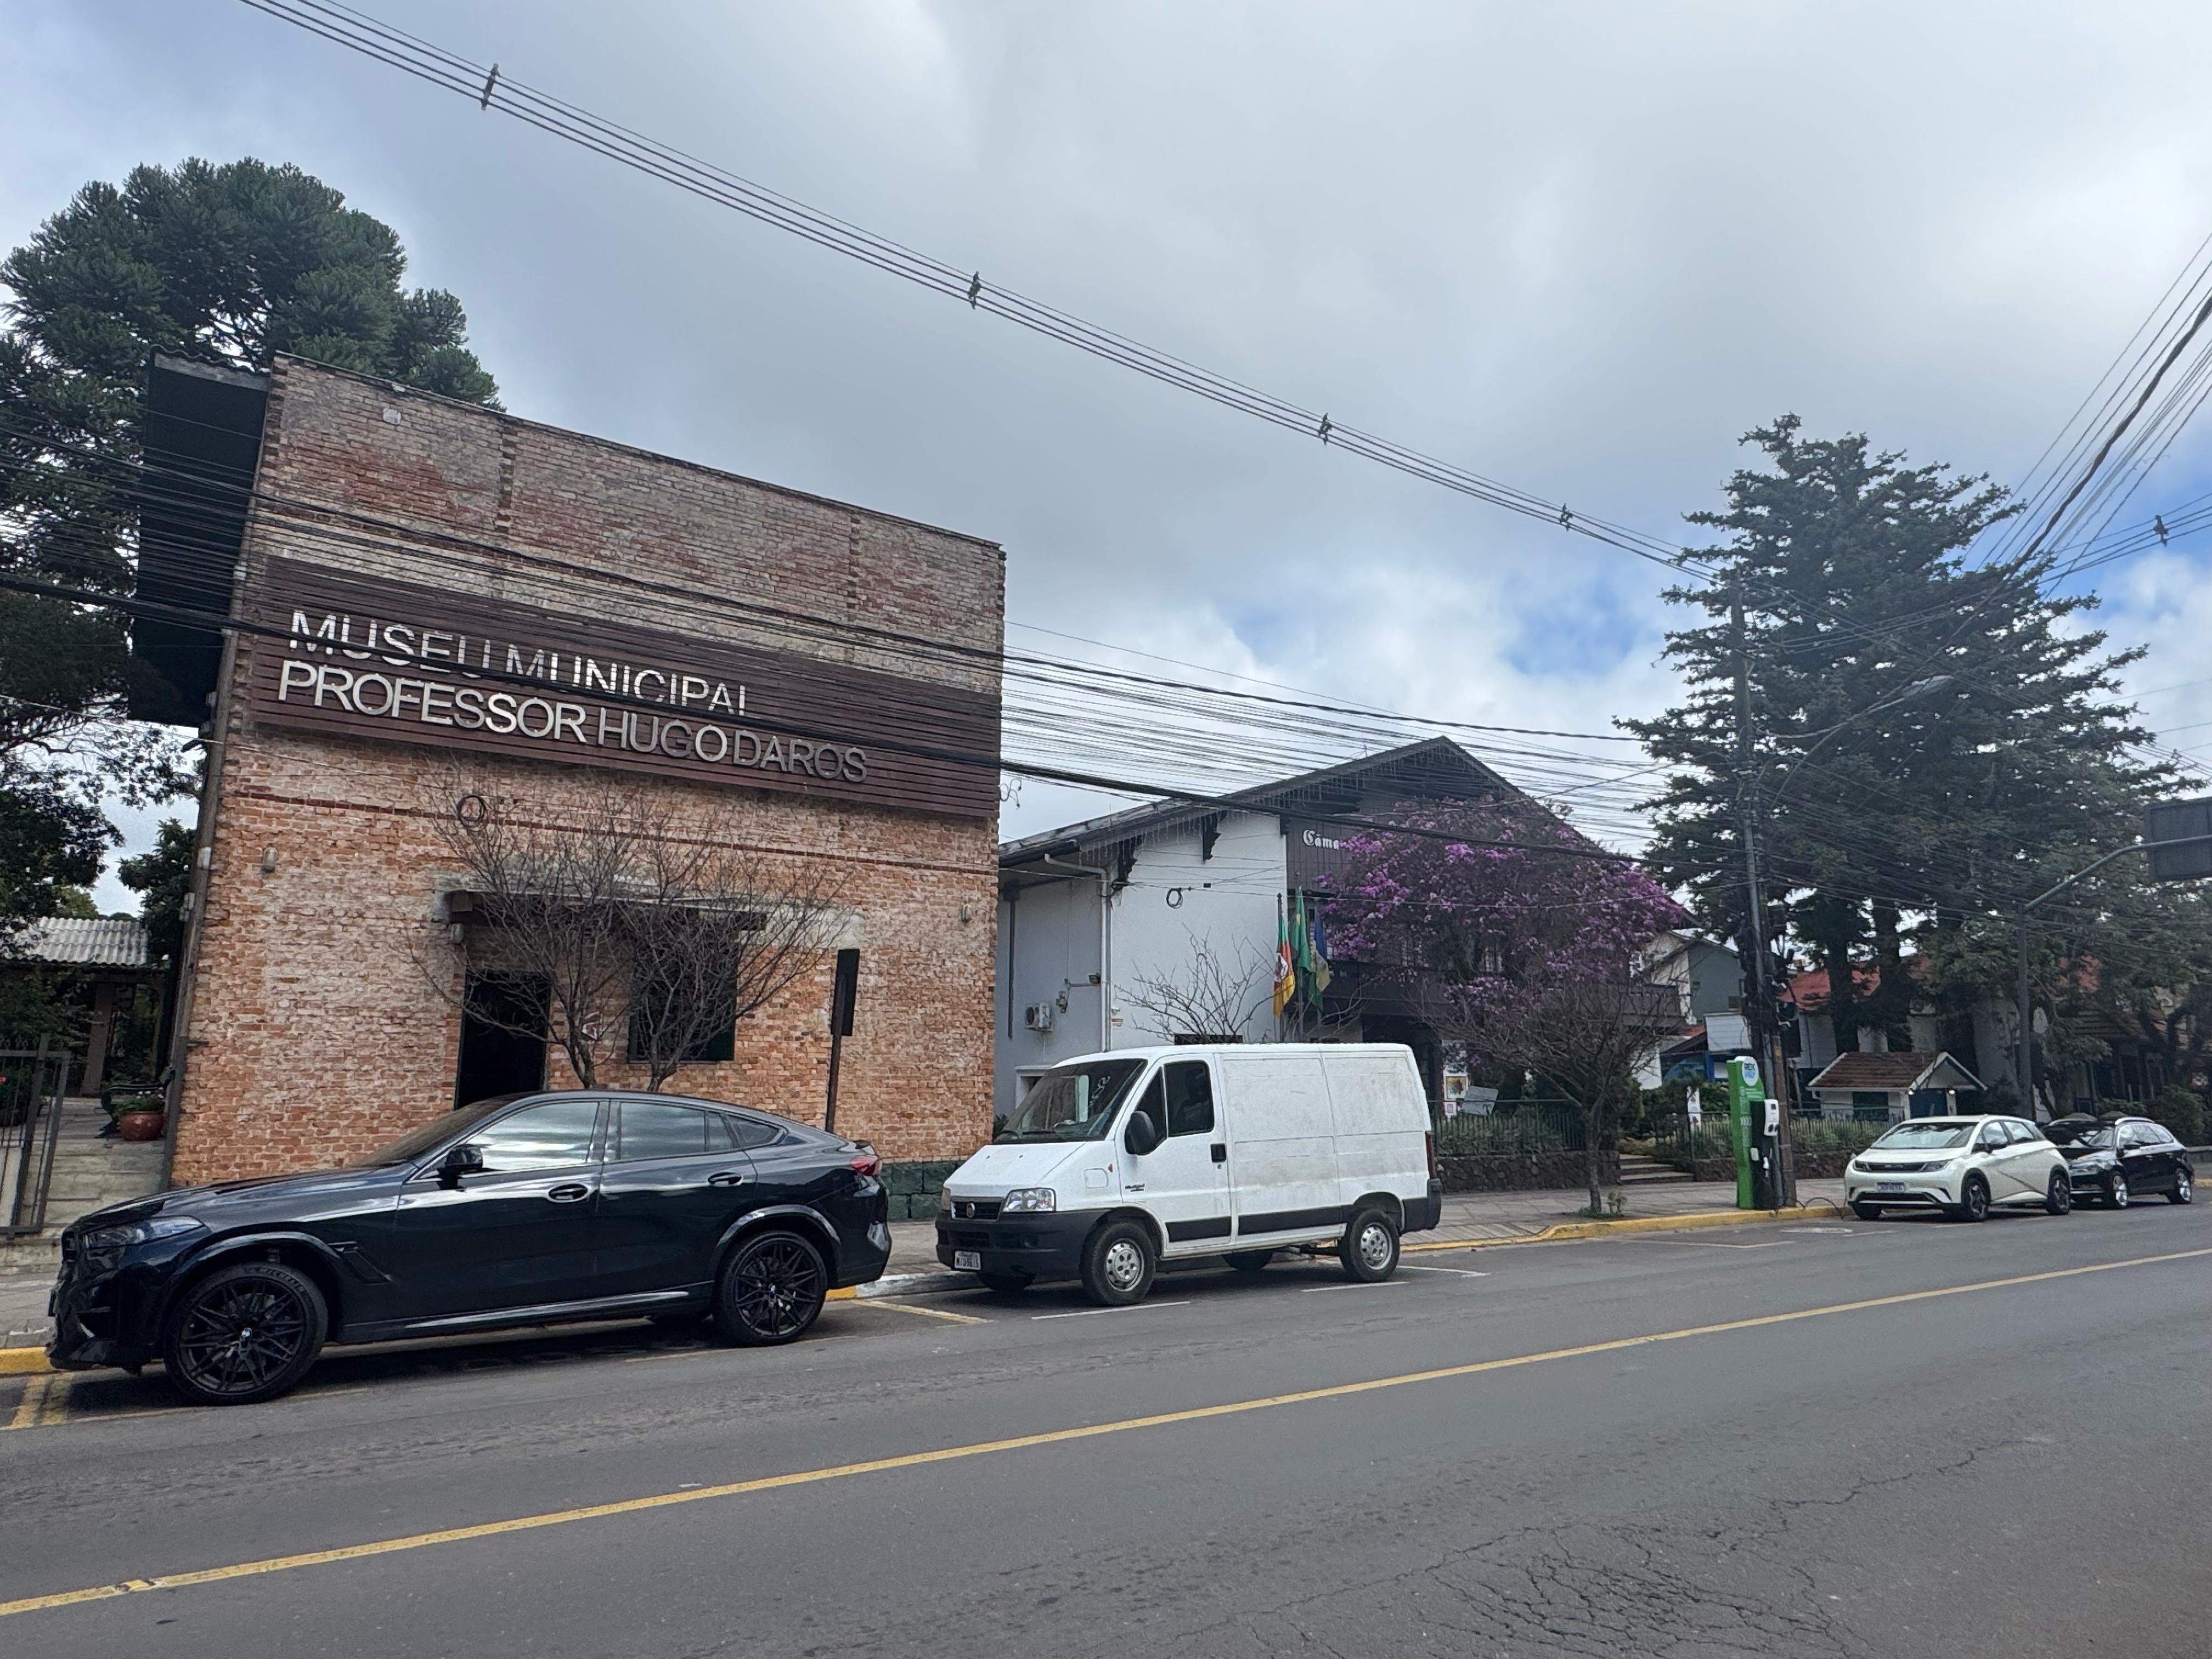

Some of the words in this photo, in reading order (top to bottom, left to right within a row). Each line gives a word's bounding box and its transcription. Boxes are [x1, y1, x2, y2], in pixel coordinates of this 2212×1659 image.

[290, 610, 490, 679] MUSEU
[278, 659, 588, 744] PROFESSOR
[598, 707, 728, 762] HUGO
[732, 730, 868, 783] DAROS
[1303, 830, 1340, 850] Câma
